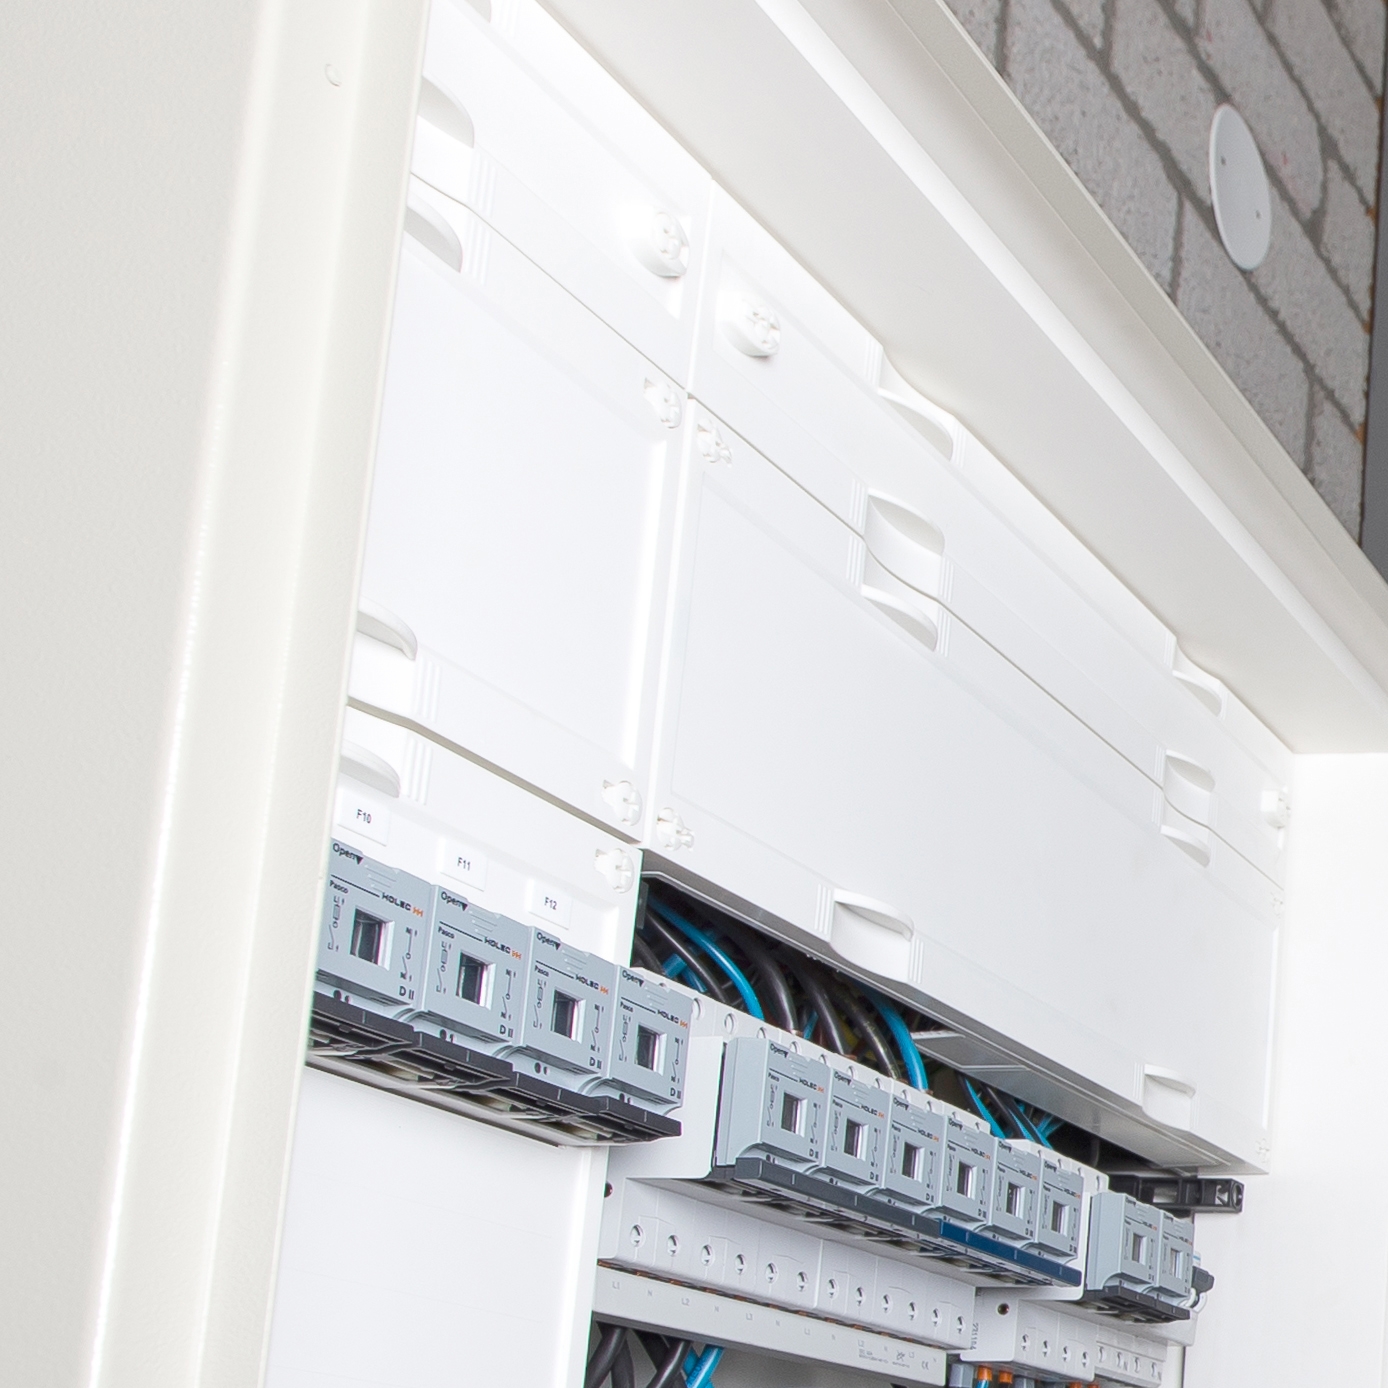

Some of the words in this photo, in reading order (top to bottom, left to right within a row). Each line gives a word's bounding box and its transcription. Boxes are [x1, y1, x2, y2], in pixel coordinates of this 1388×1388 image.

[356, 808, 372, 824] F10
[332, 843, 356, 860] Open
[457, 856, 470, 871] F11
[382, 892, 411, 911] HOLEC
[440, 891, 461, 908] Open
[544, 897, 557, 910] F12
[484, 936, 511, 954] HOLEC
[575, 974, 599, 990] HOLEC
[656, 1009, 679, 1024] HOLEC
